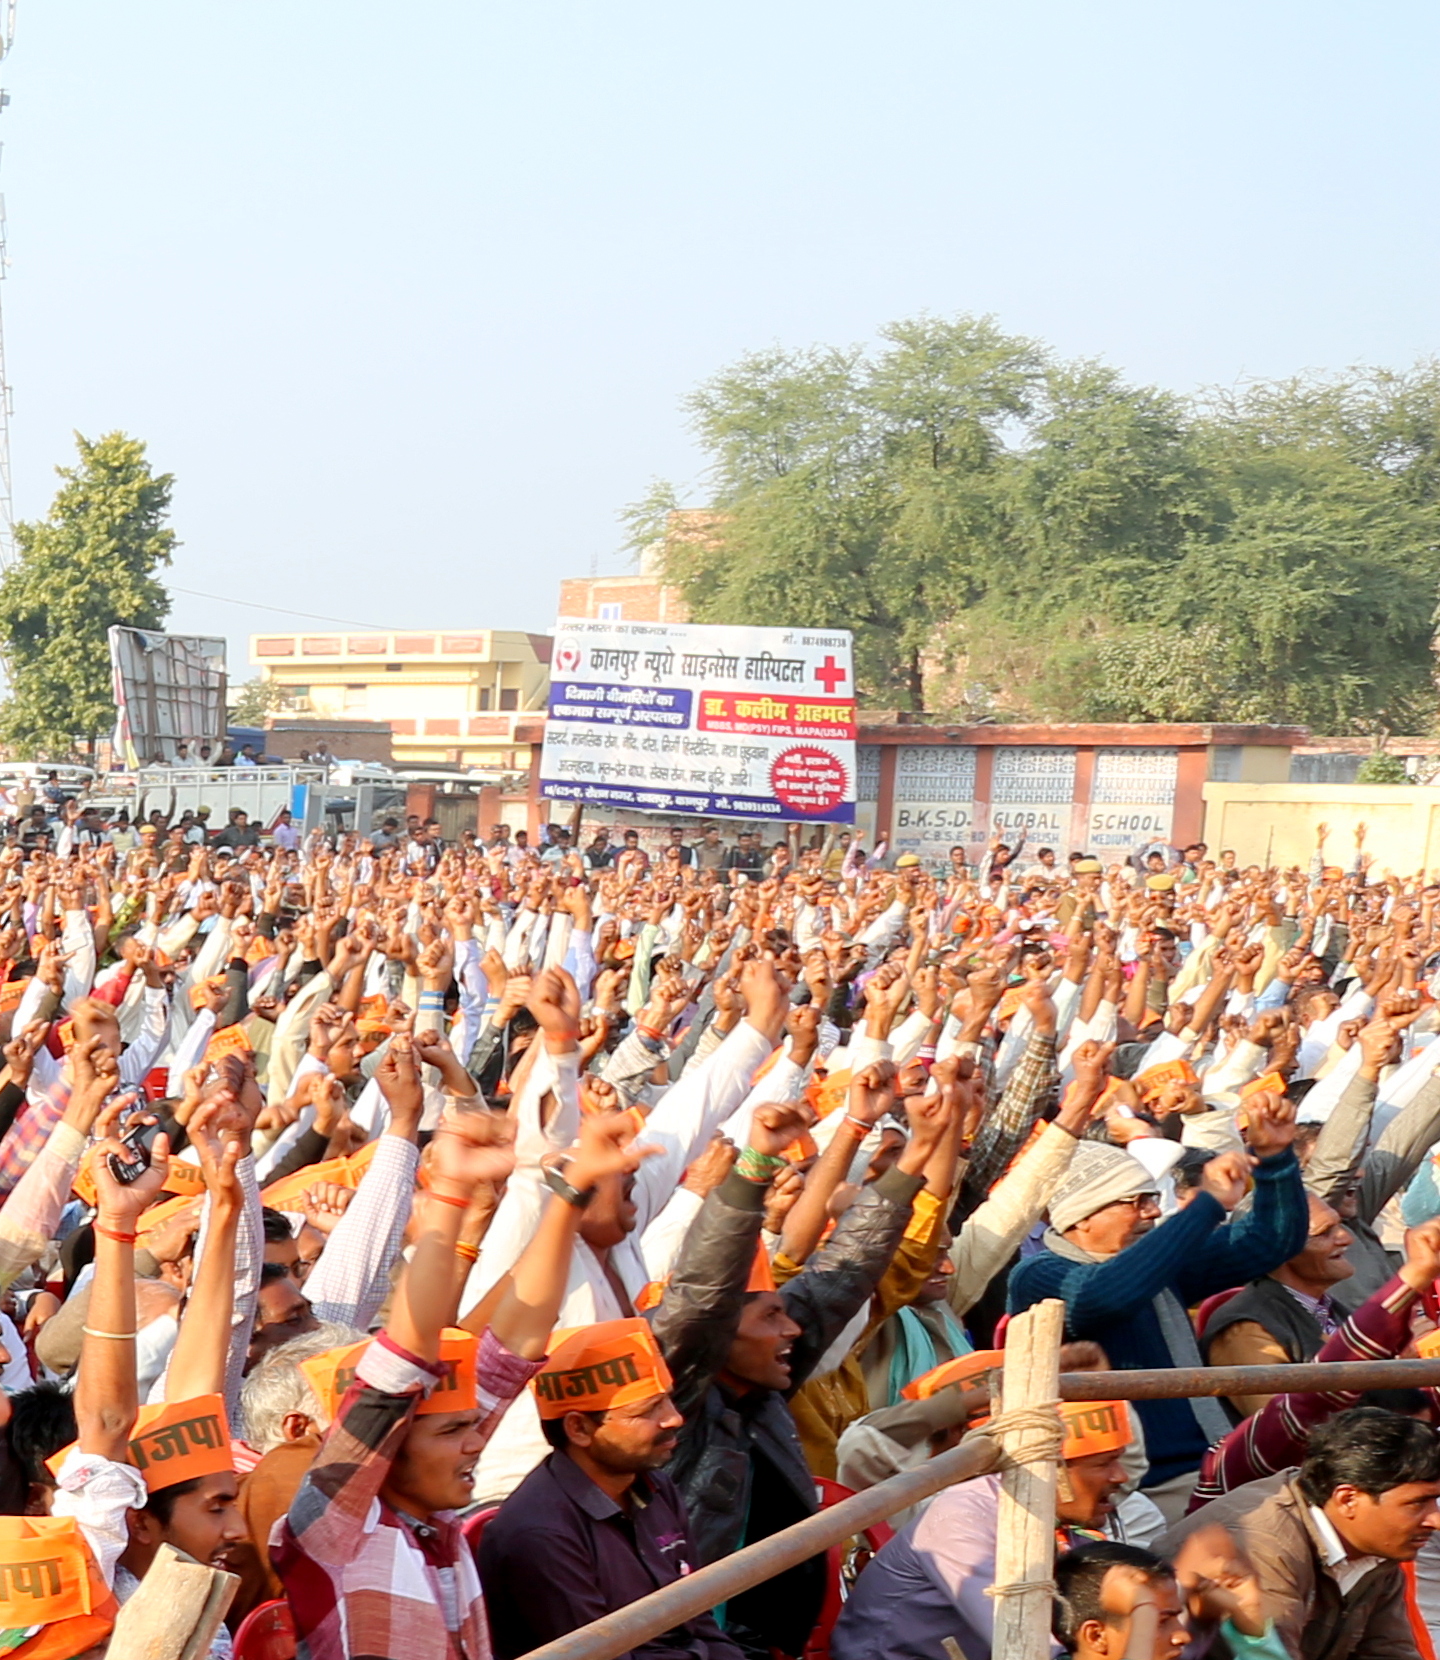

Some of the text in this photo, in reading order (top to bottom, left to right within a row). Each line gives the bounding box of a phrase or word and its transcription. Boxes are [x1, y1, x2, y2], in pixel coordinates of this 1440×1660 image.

[587, 623, 612, 633] भारत
[614, 624, 629, 634] का
[590, 648, 640, 681] कानपुर
[644, 646, 676, 683] न्यूरो
[681, 648, 740, 681] साइन्सेस
[565, 684, 605, 702] दिमागी
[656, 694, 675, 706] का
[704, 697, 852, 724] डा. कलीम अहमद
[795, 726, 848, 739] MAPA(USA)
[897, 809, 1164, 832] B.K.S.D. GLOBAL SCHOOL
